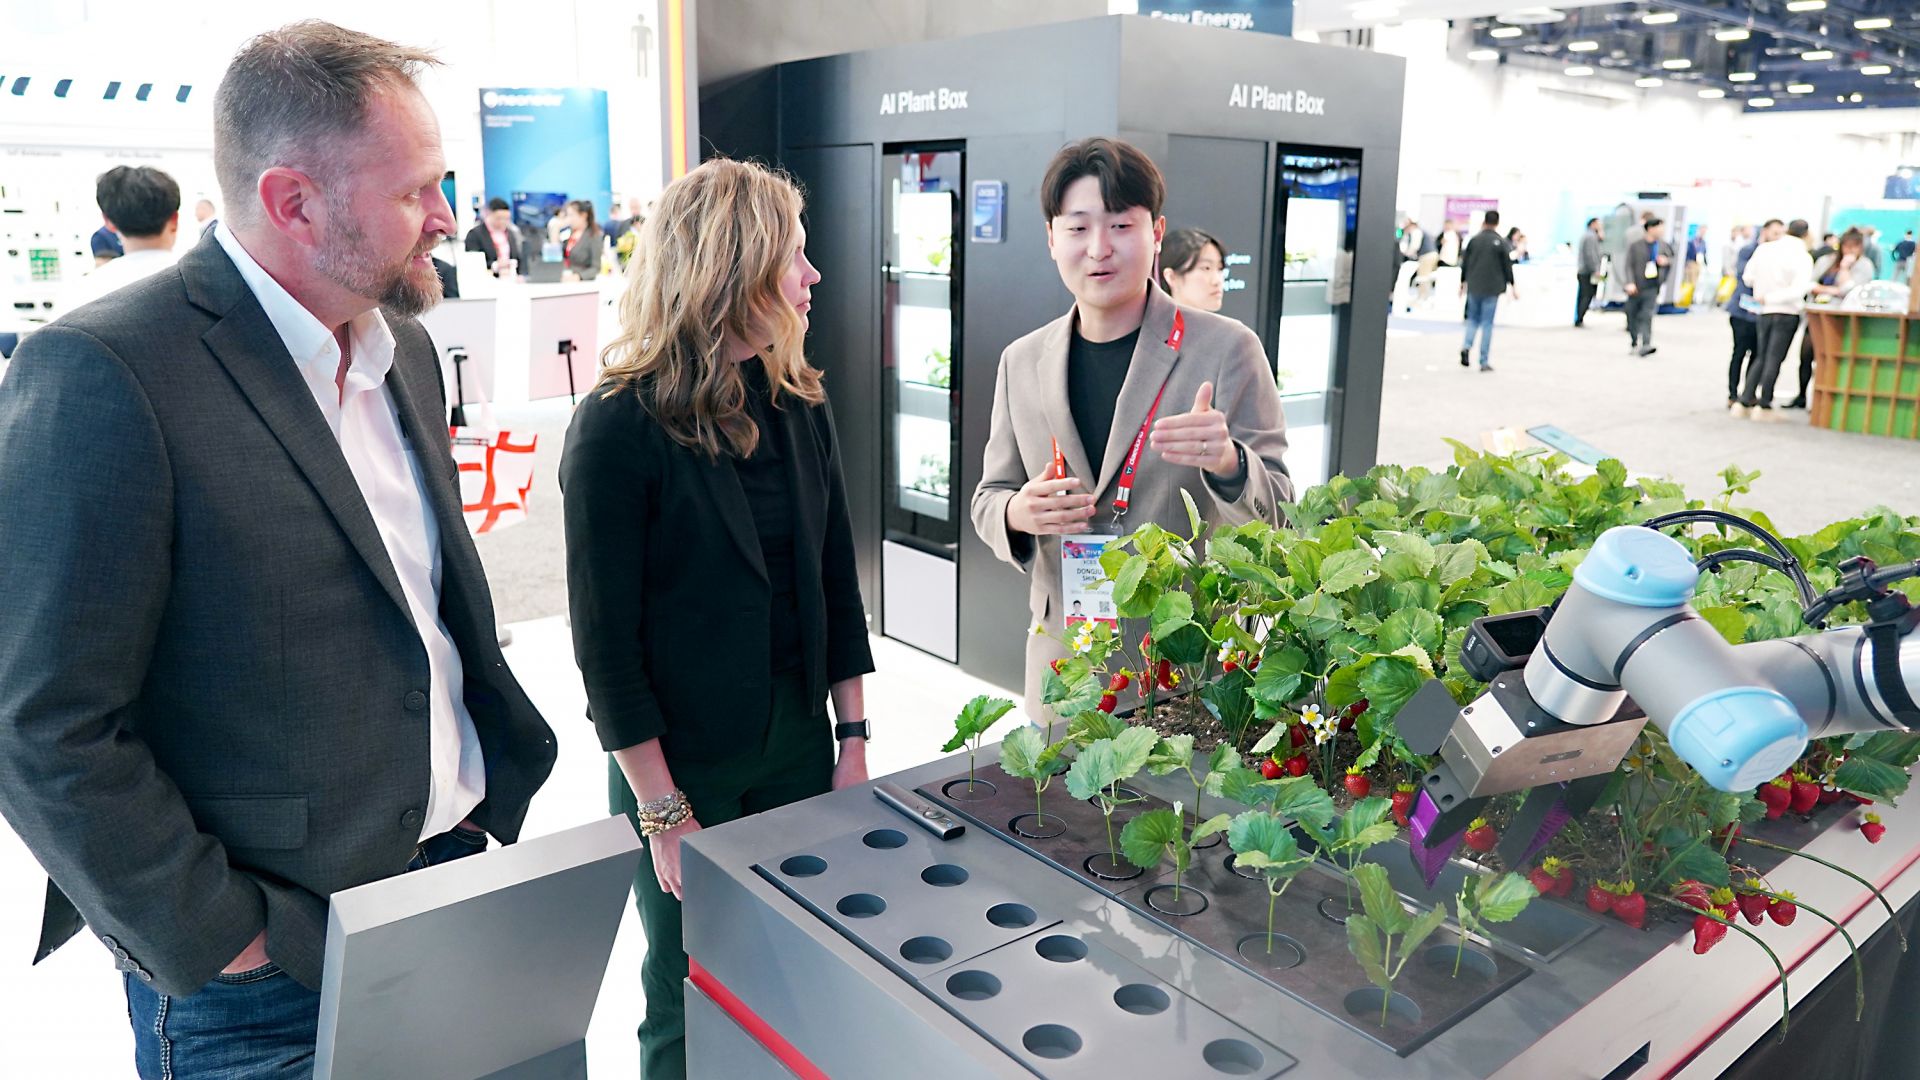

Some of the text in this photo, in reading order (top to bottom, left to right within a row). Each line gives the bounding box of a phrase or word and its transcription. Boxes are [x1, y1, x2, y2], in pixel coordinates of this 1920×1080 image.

[1192, 10, 1254, 29] Energy.
[880, 87, 968, 115] AI Plant Box
[1229, 83, 1325, 115] AI Plant Box
